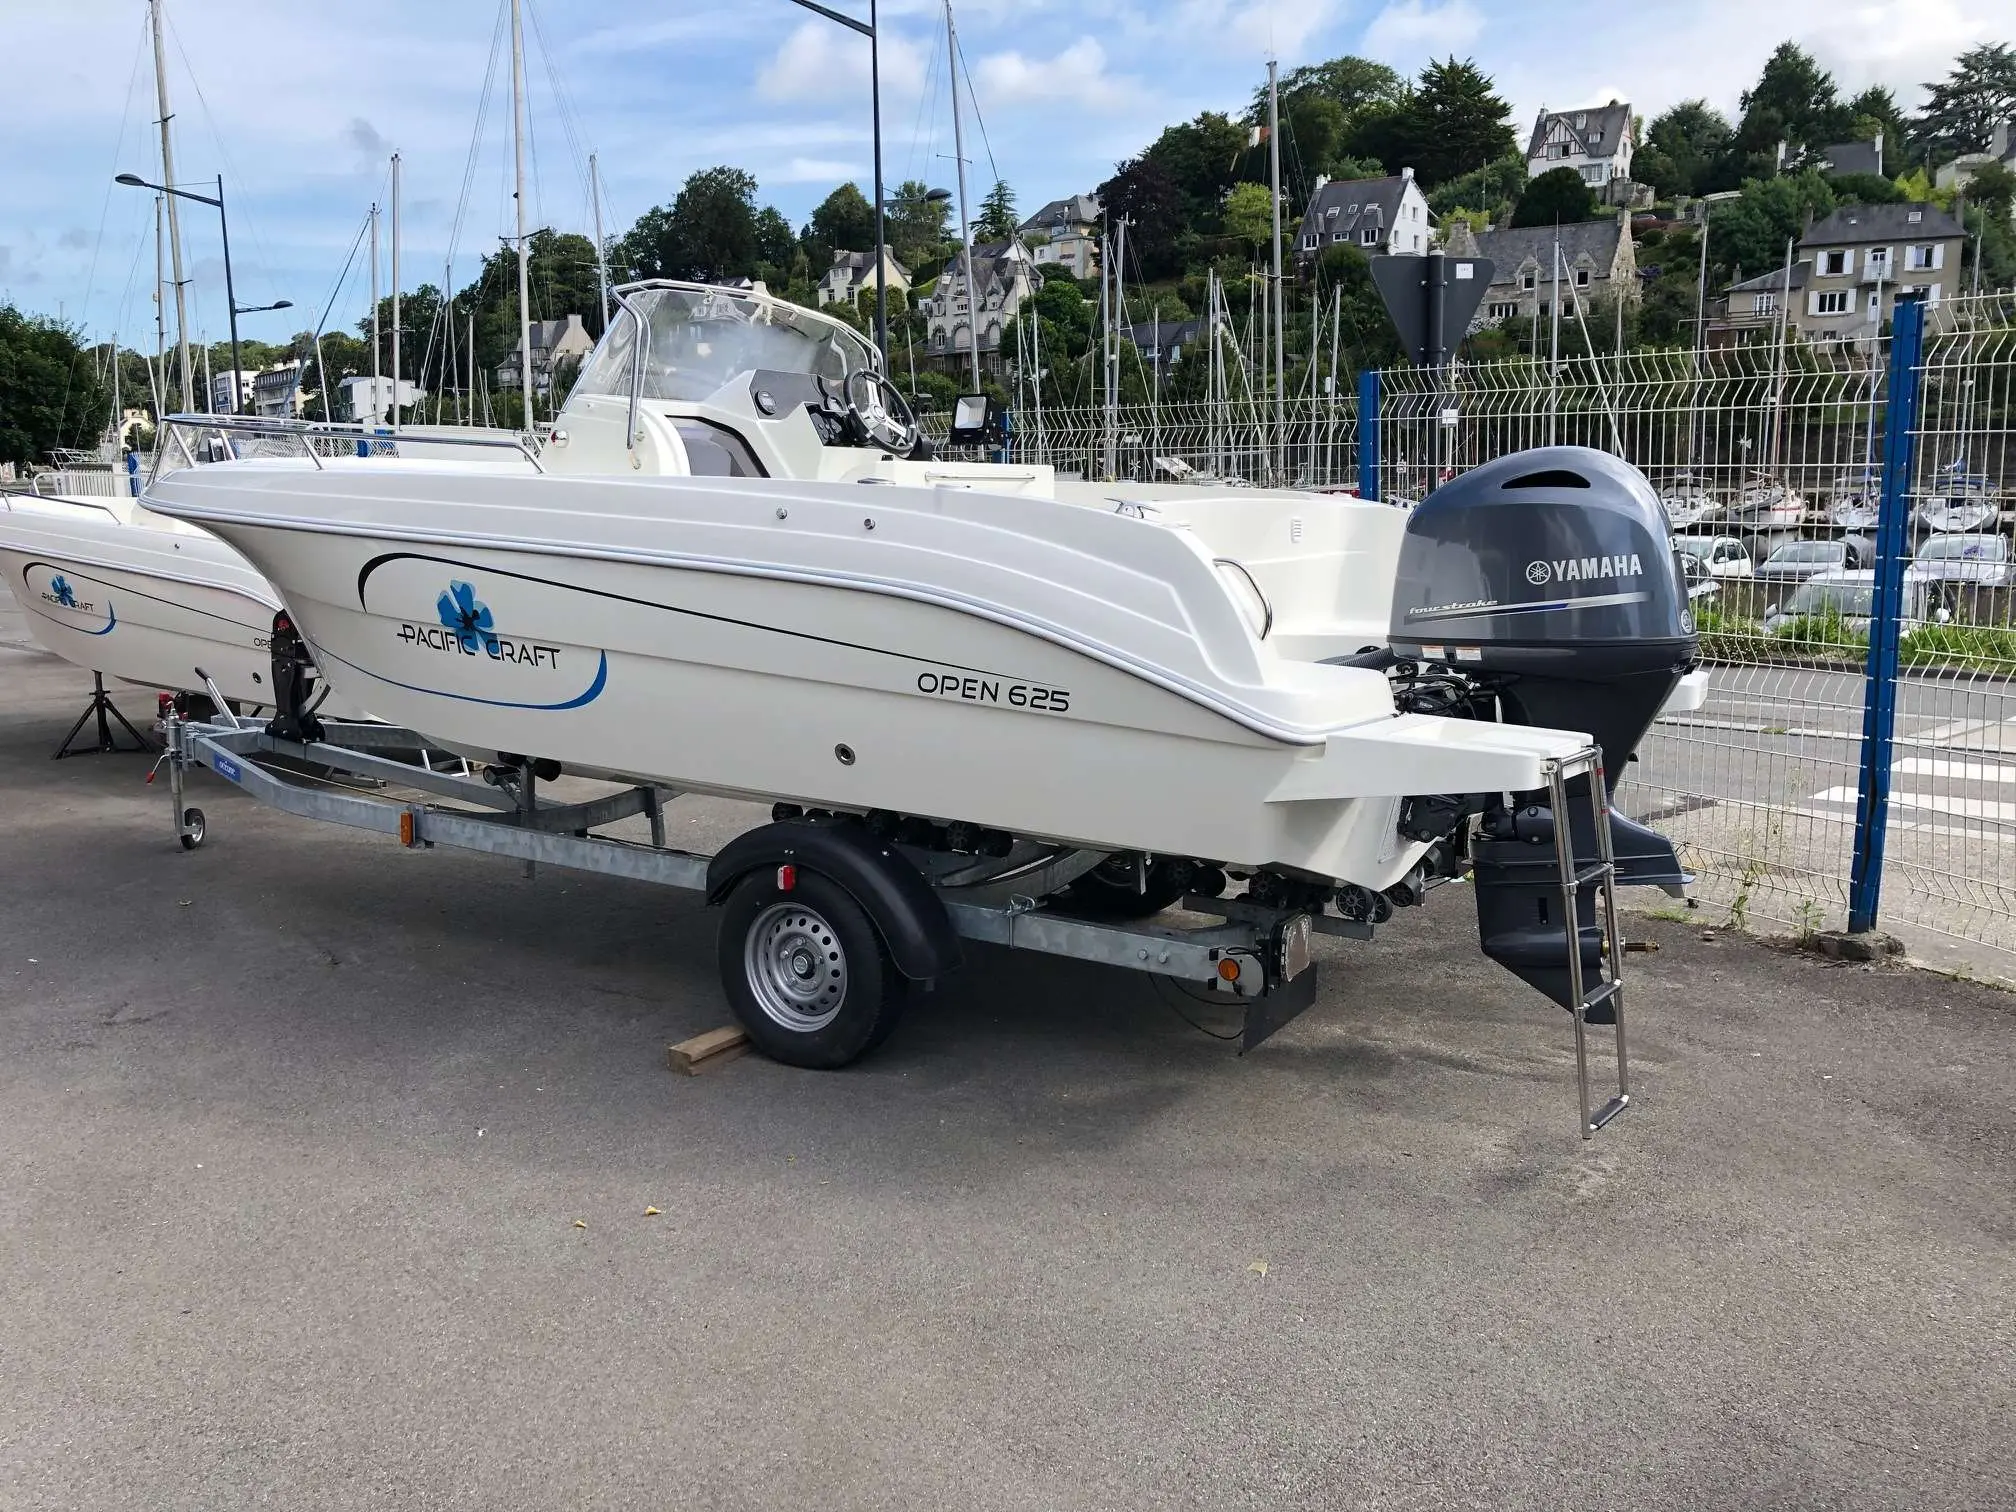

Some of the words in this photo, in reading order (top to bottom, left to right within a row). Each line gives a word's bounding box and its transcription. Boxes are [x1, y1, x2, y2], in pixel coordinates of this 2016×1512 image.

[1553, 553, 1643, 582] YAMAHA
[397, 623, 476, 656] PACIFIC
[486, 638, 561, 669] CRAFT
[917, 672, 1000, 703] OPEN
[1008, 685, 1071, 713] 625
